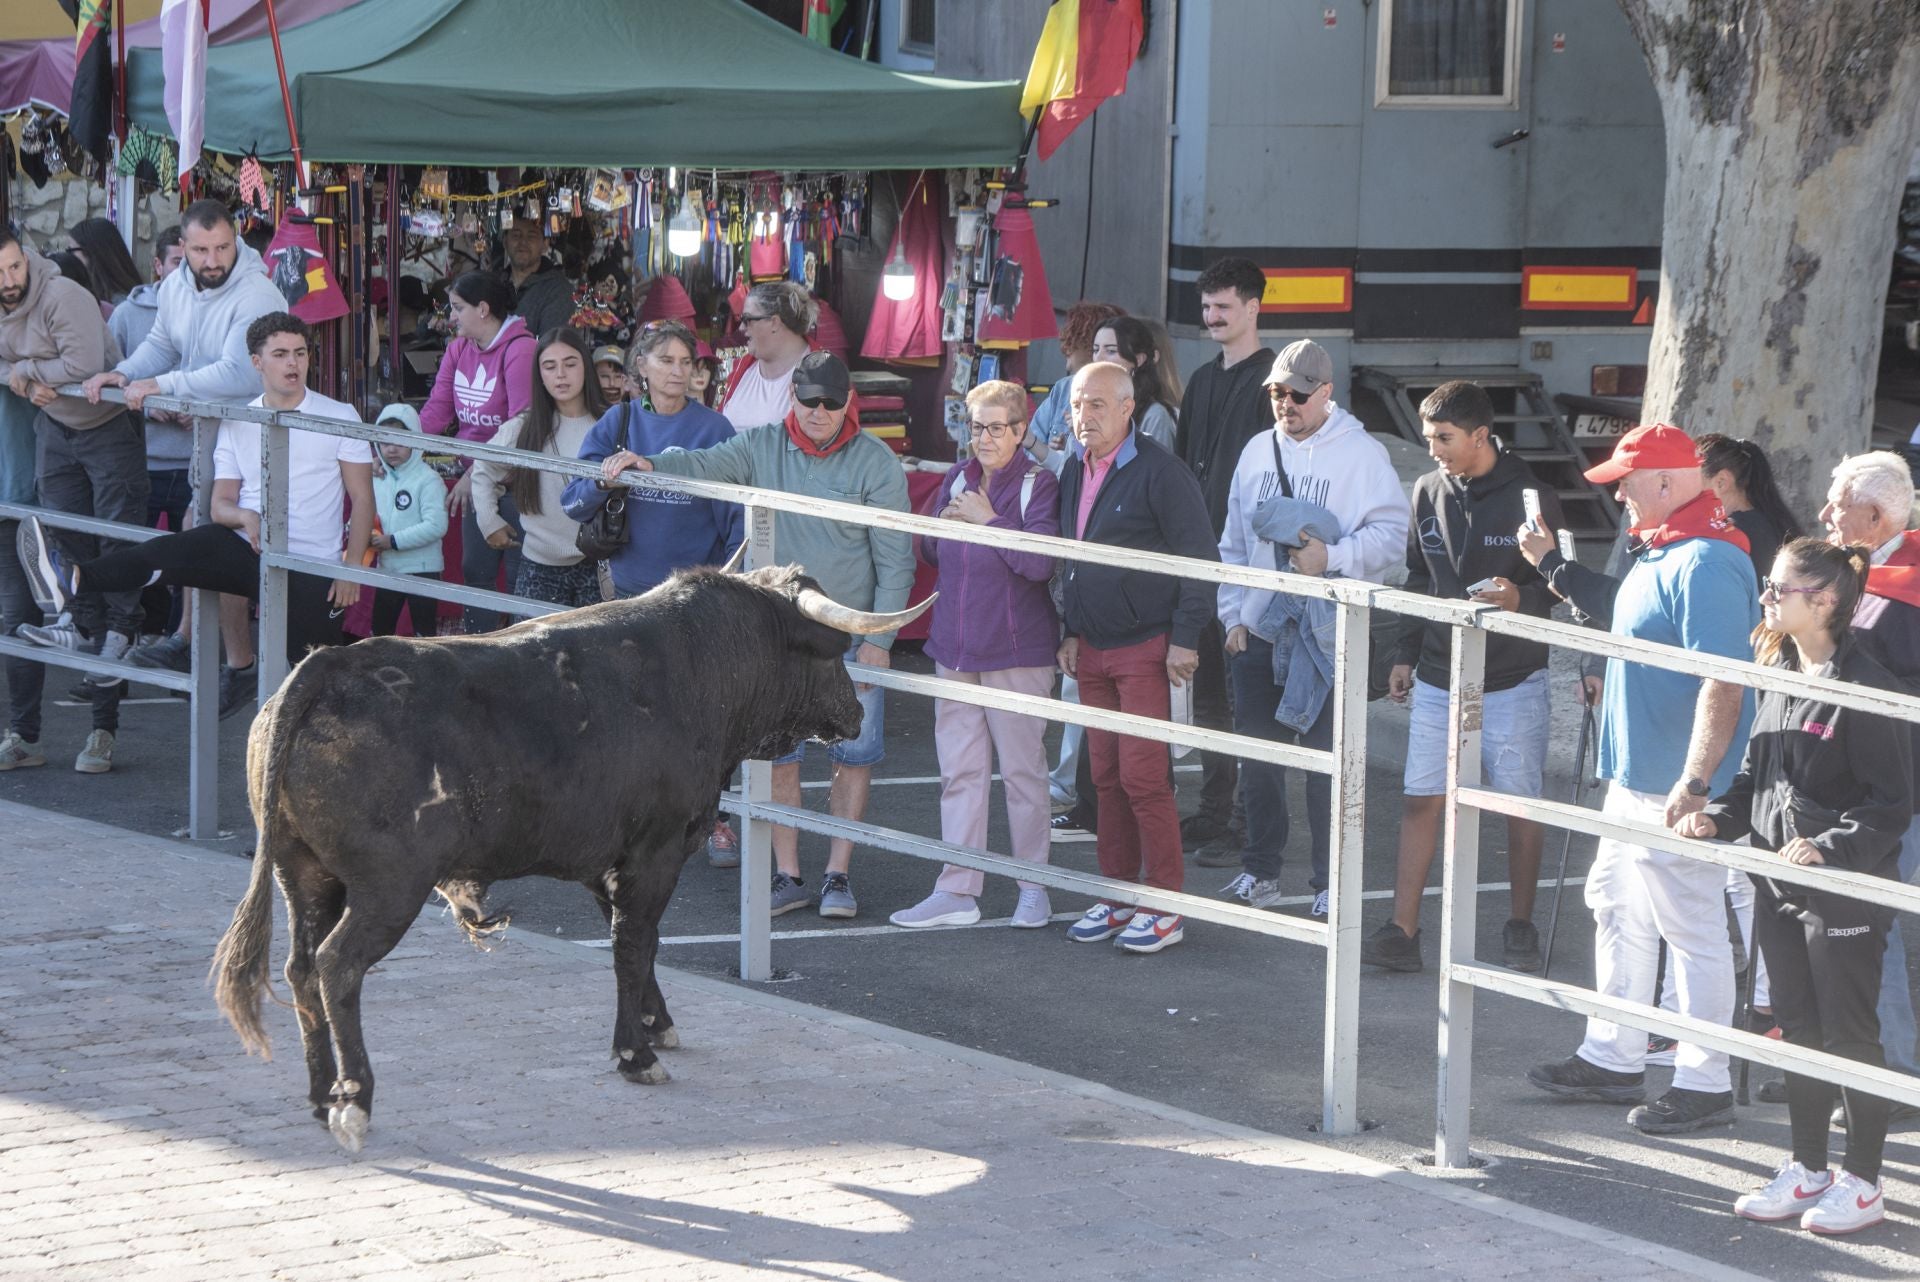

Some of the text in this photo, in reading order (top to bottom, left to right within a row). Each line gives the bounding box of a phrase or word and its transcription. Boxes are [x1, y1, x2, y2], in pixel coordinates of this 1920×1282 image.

[456, 407, 502, 427] didas
[1297, 474, 1331, 509] CIAO
[1484, 535, 1519, 546] BOSS
[1827, 925, 1870, 937] Kappa
